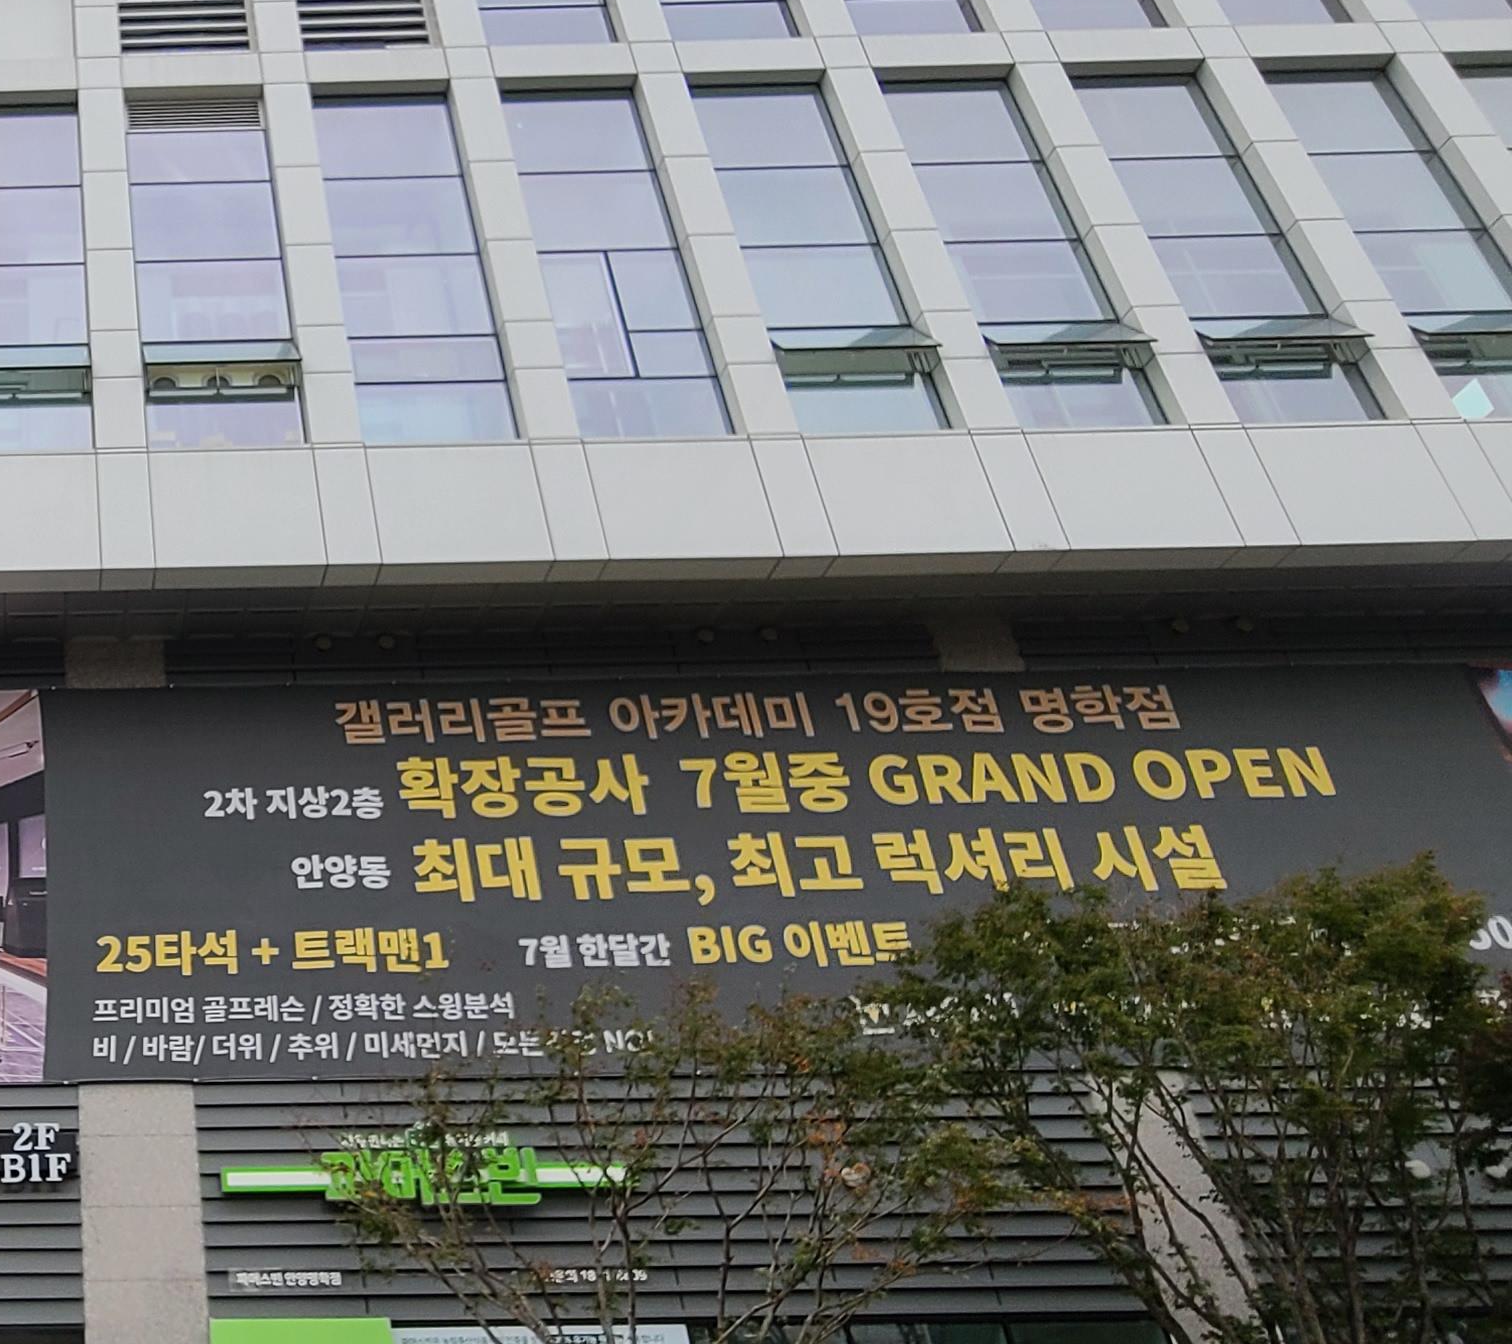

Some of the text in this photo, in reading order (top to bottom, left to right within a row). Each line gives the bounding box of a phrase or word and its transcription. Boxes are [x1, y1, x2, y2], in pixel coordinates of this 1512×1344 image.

[335, 683, 1181, 745] 갤러리골프 아카데미 19호점 명학점
[203, 745, 1337, 820] 2차 지상2층 확장공사 7월중 GRAND OPEN
[291, 823, 1228, 905] 안양동 최대 규모, 최고 럭셔리 시설
[96, 919, 912, 976] 25타석 + 트랙맨1 7월 한달간 BIG 이벤트
[93, 997, 195, 1024] 프리미엄
[202, 995, 306, 1024] 골프레슨
[328, 993, 406, 1022] 정확한
[413, 991, 515, 1020] 스윙분석
[93, 1035, 117, 1063] 비
[212, 1032, 263, 1063] 더위
[287, 1031, 339, 1060] 추위
[364, 1030, 467, 1060] 미세먼지
[11, 1122, 61, 1152] 2F
[0, 1152, 71, 1184] B1F
